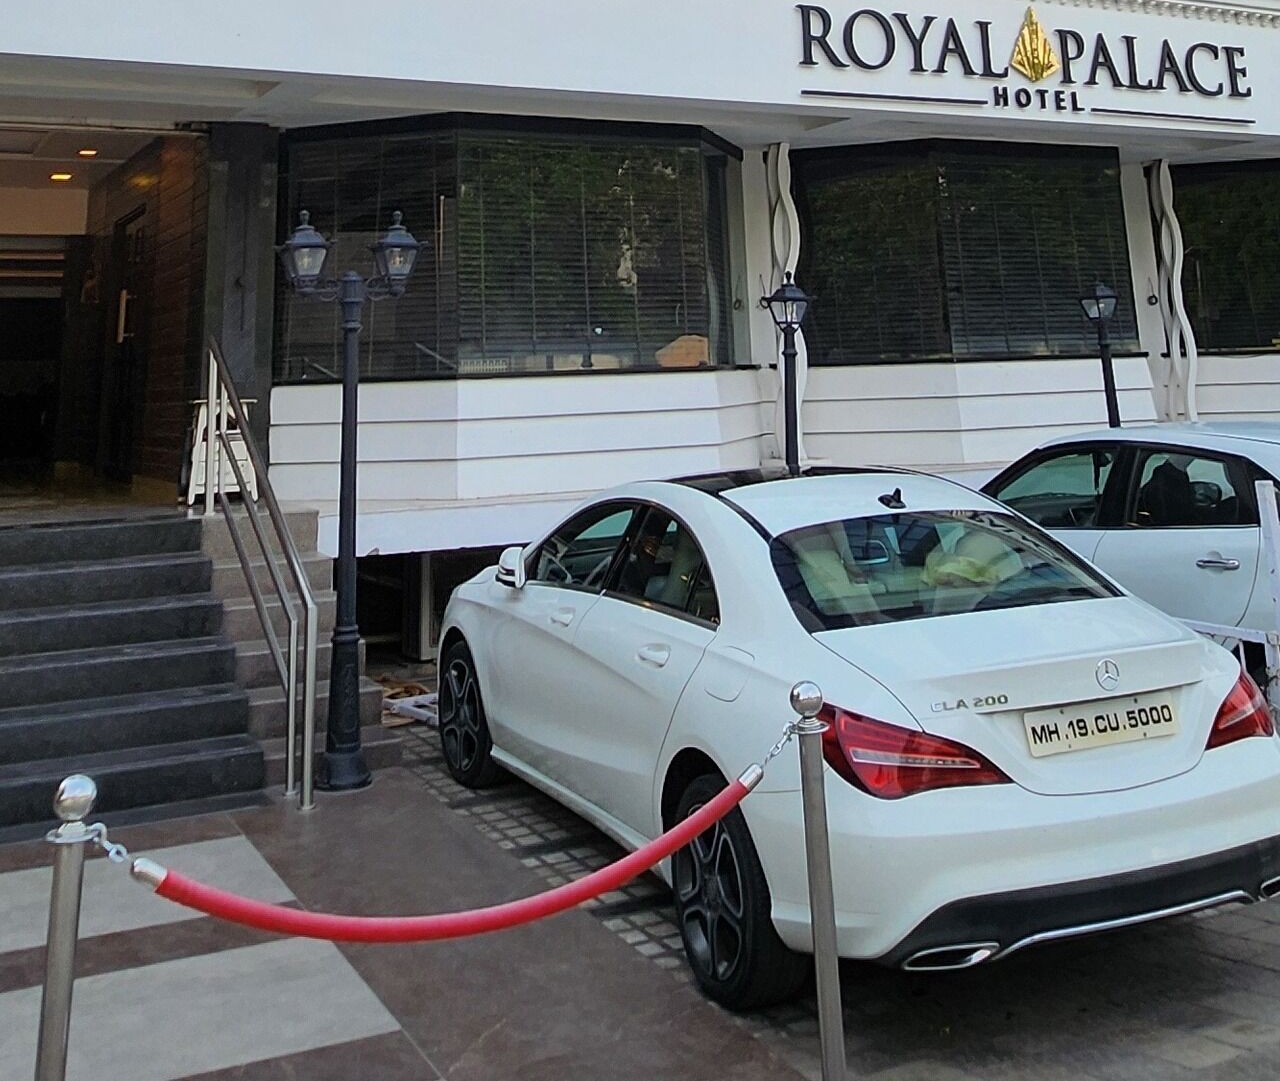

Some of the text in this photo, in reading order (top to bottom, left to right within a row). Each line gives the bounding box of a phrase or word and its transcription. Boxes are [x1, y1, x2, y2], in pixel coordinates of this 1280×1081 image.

[795, 3, 1254, 99] ROYAL PALACE
[993, 86, 1086, 113] HOTEL
[930, 695, 1008, 713] CLA 200
